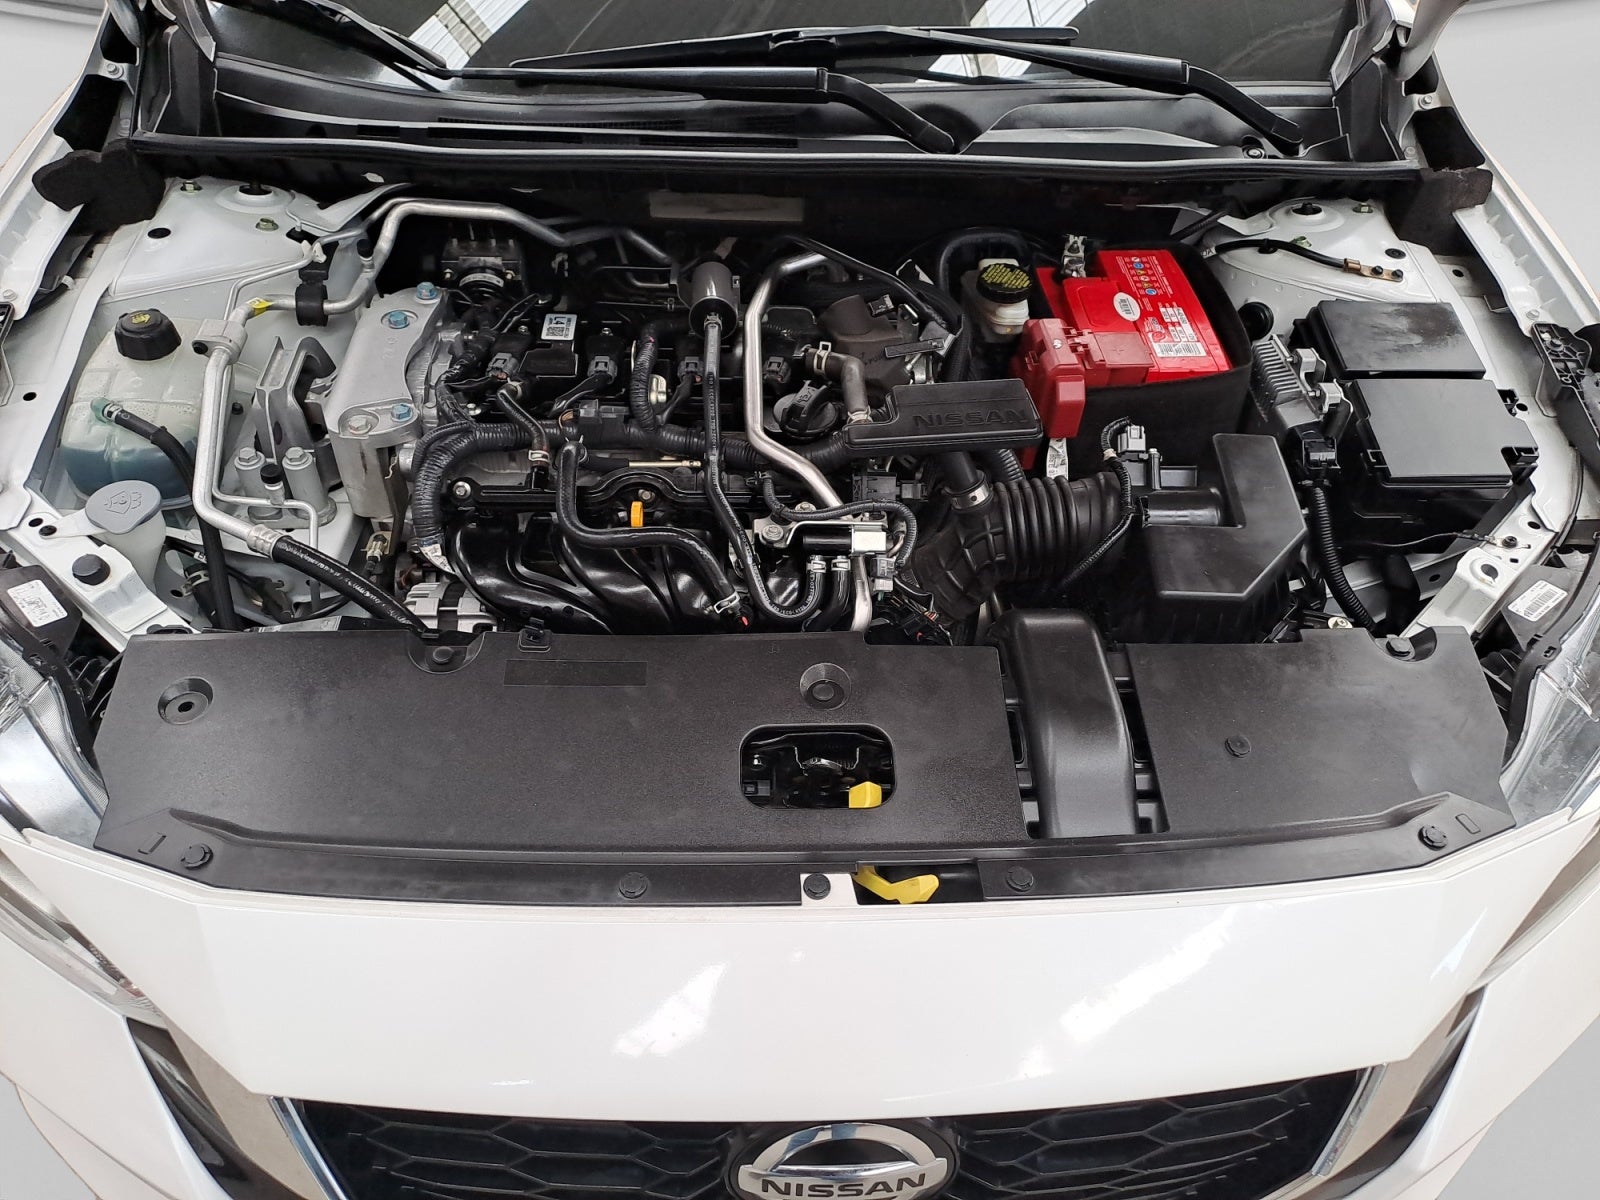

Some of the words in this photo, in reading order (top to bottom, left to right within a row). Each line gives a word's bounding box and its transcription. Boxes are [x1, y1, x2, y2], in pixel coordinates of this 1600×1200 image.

[553, 316, 567, 325] L4
[912, 408, 1028, 427] NISSAN
[761, 1173, 926, 1198] NISSAN
